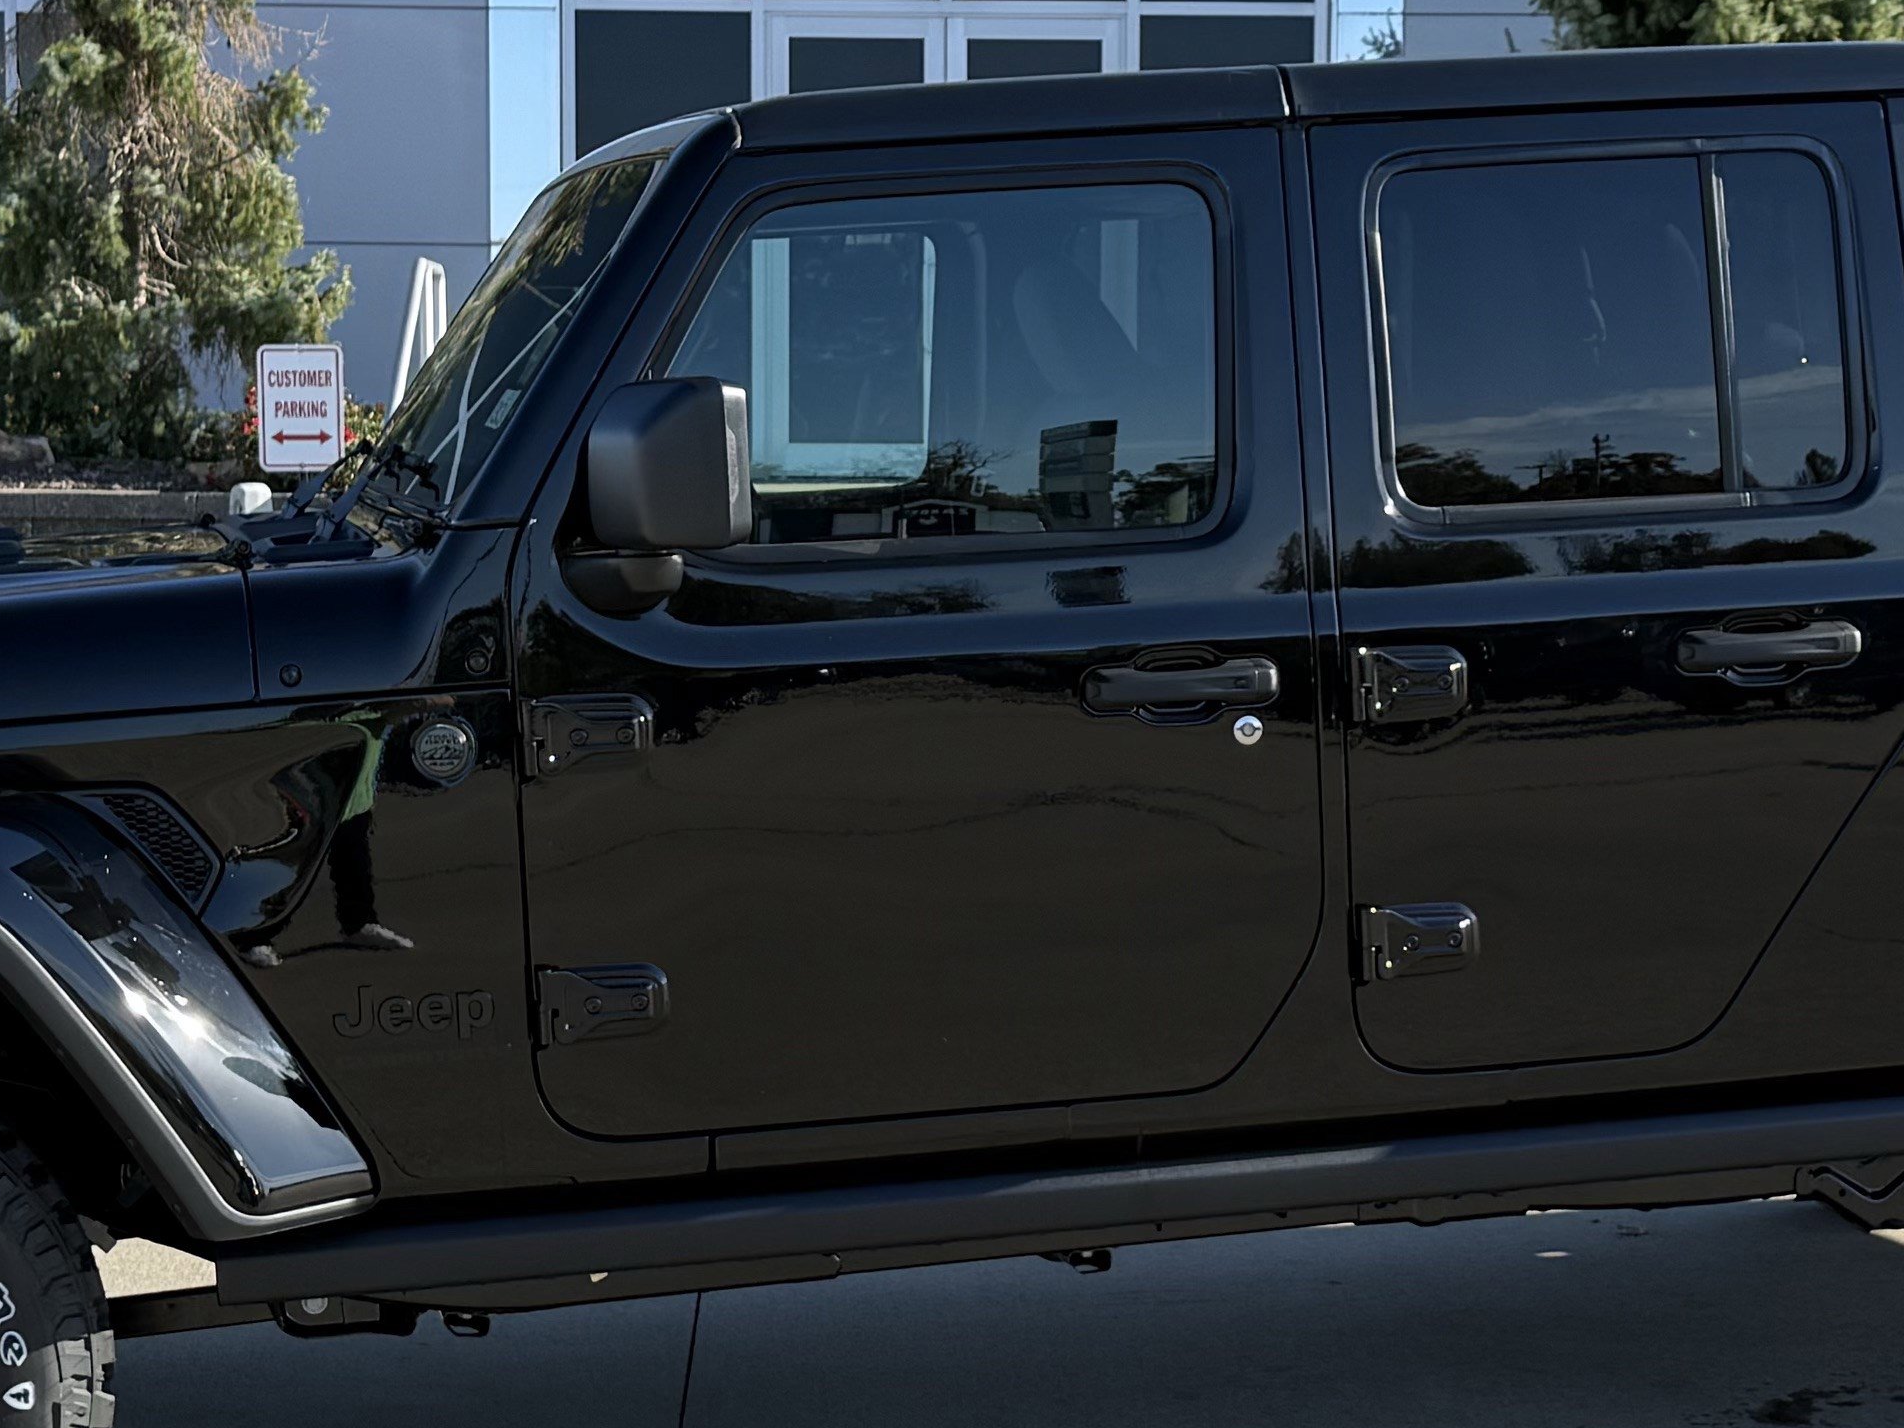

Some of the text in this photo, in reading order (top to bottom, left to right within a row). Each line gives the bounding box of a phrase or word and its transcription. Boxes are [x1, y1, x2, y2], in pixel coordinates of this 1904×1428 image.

[268, 369, 333, 388] CUSTOMER
[274, 400, 328, 419] PARKING
[332, 984, 495, 1040] Jeep
